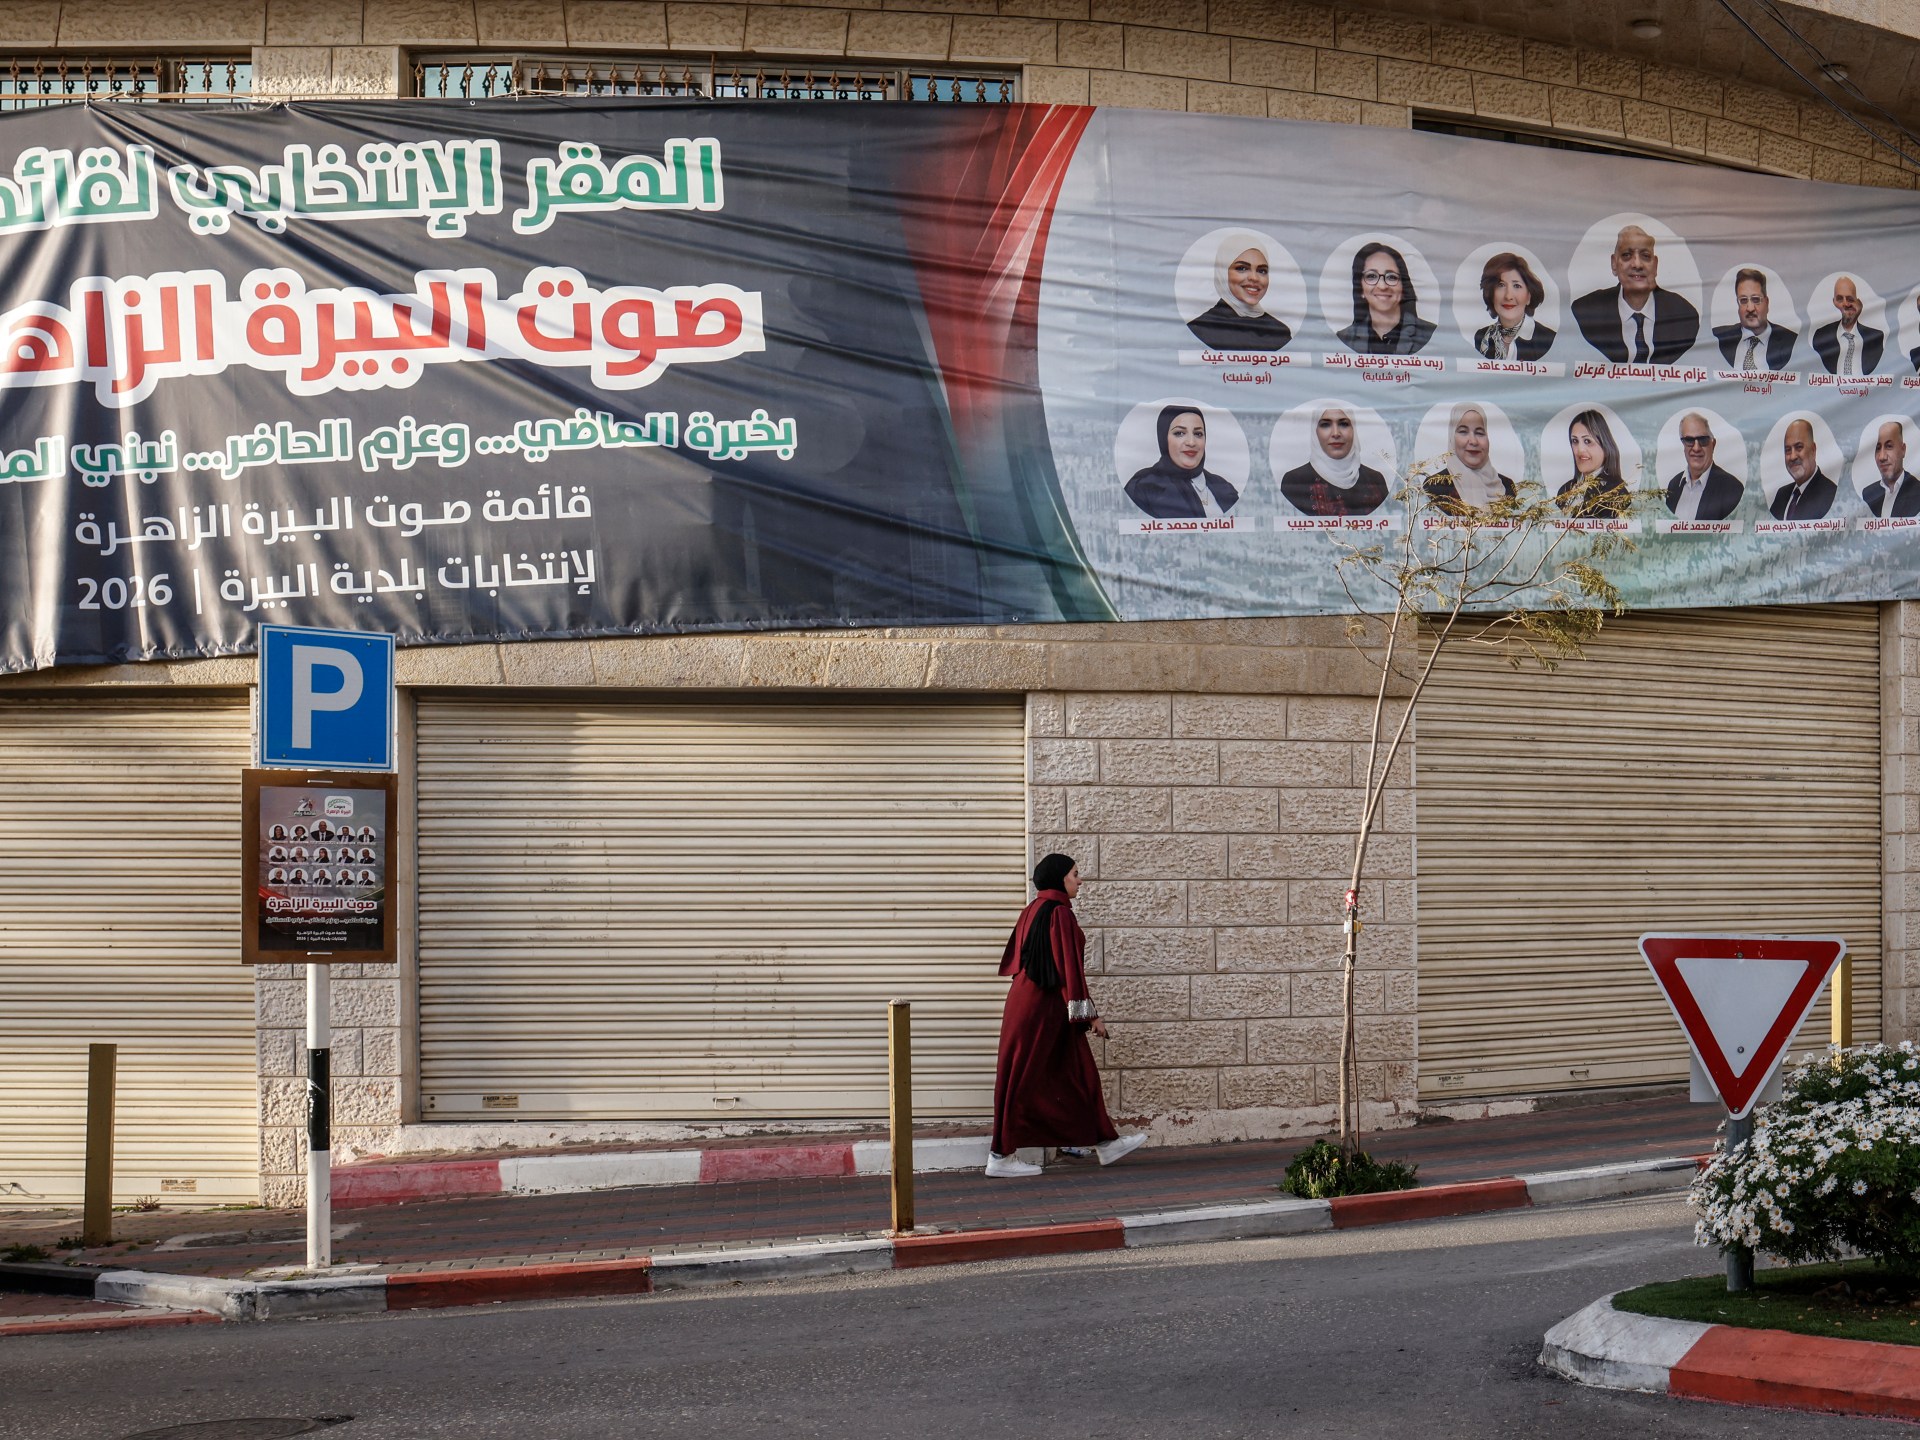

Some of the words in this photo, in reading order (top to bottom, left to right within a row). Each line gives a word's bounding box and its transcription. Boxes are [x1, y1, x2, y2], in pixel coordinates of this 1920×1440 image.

[175, 146, 496, 231] الإنتخابي
[520, 144, 716, 227] المقر
[246, 281, 487, 382] البيرة
[516, 279, 743, 377] صوت
[1201, 350, 1224, 365] غيث
[1227, 354, 1268, 366] موسى
[1269, 354, 1290, 367] مرح
[1325, 353, 1352, 368] راشد
[1354, 354, 1389, 369] توفيق
[1391, 356, 1422, 369] فتحي
[1424, 358, 1444, 371] ربى
[1502, 359, 1524, 372] أحمد
[1526, 362, 1538, 376] رنا
[1607, 364, 1656, 382] إسماعيل
[1254, 371, 1273, 385] (أبو
[1658, 367, 1682, 382] علي
[1684, 368, 1707, 382] عزام
[688, 412, 793, 457] بخبرة
[362, 419, 465, 468] وعزم
[75, 434, 174, 483] نبني
[482, 483, 592, 522] قائمة
[242, 495, 353, 546] البيرة
[365, 495, 472, 537] صوت
[1318, 515, 1342, 531] أمجد
[75, 503, 231, 556] الزاهرة
[1140, 519, 1164, 533] عابد
[1166, 521, 1198, 530] محمد
[1200, 516, 1235, 532] أماني
[1287, 518, 1315, 531] حبيب
[1586, 519, 1604, 530] خالد
[1670, 521, 1689, 533] غانم
[1690, 523, 1711, 531] محمد
[1772, 521, 1797, 533] الرحيم
[1798, 522, 1812, 531] عبد
[1813, 519, 1841, 531] إبراهيم
[330, 558, 426, 603] بلدية
[437, 549, 596, 598] لإنتخابات
[76, 573, 173, 610] 2026
[220, 562, 320, 612] البيرة
[291, 644, 364, 749] P
[268, 897, 309, 911] الزاهرة
[312, 898, 344, 911] البيرة
[346, 898, 375, 912] صوت
